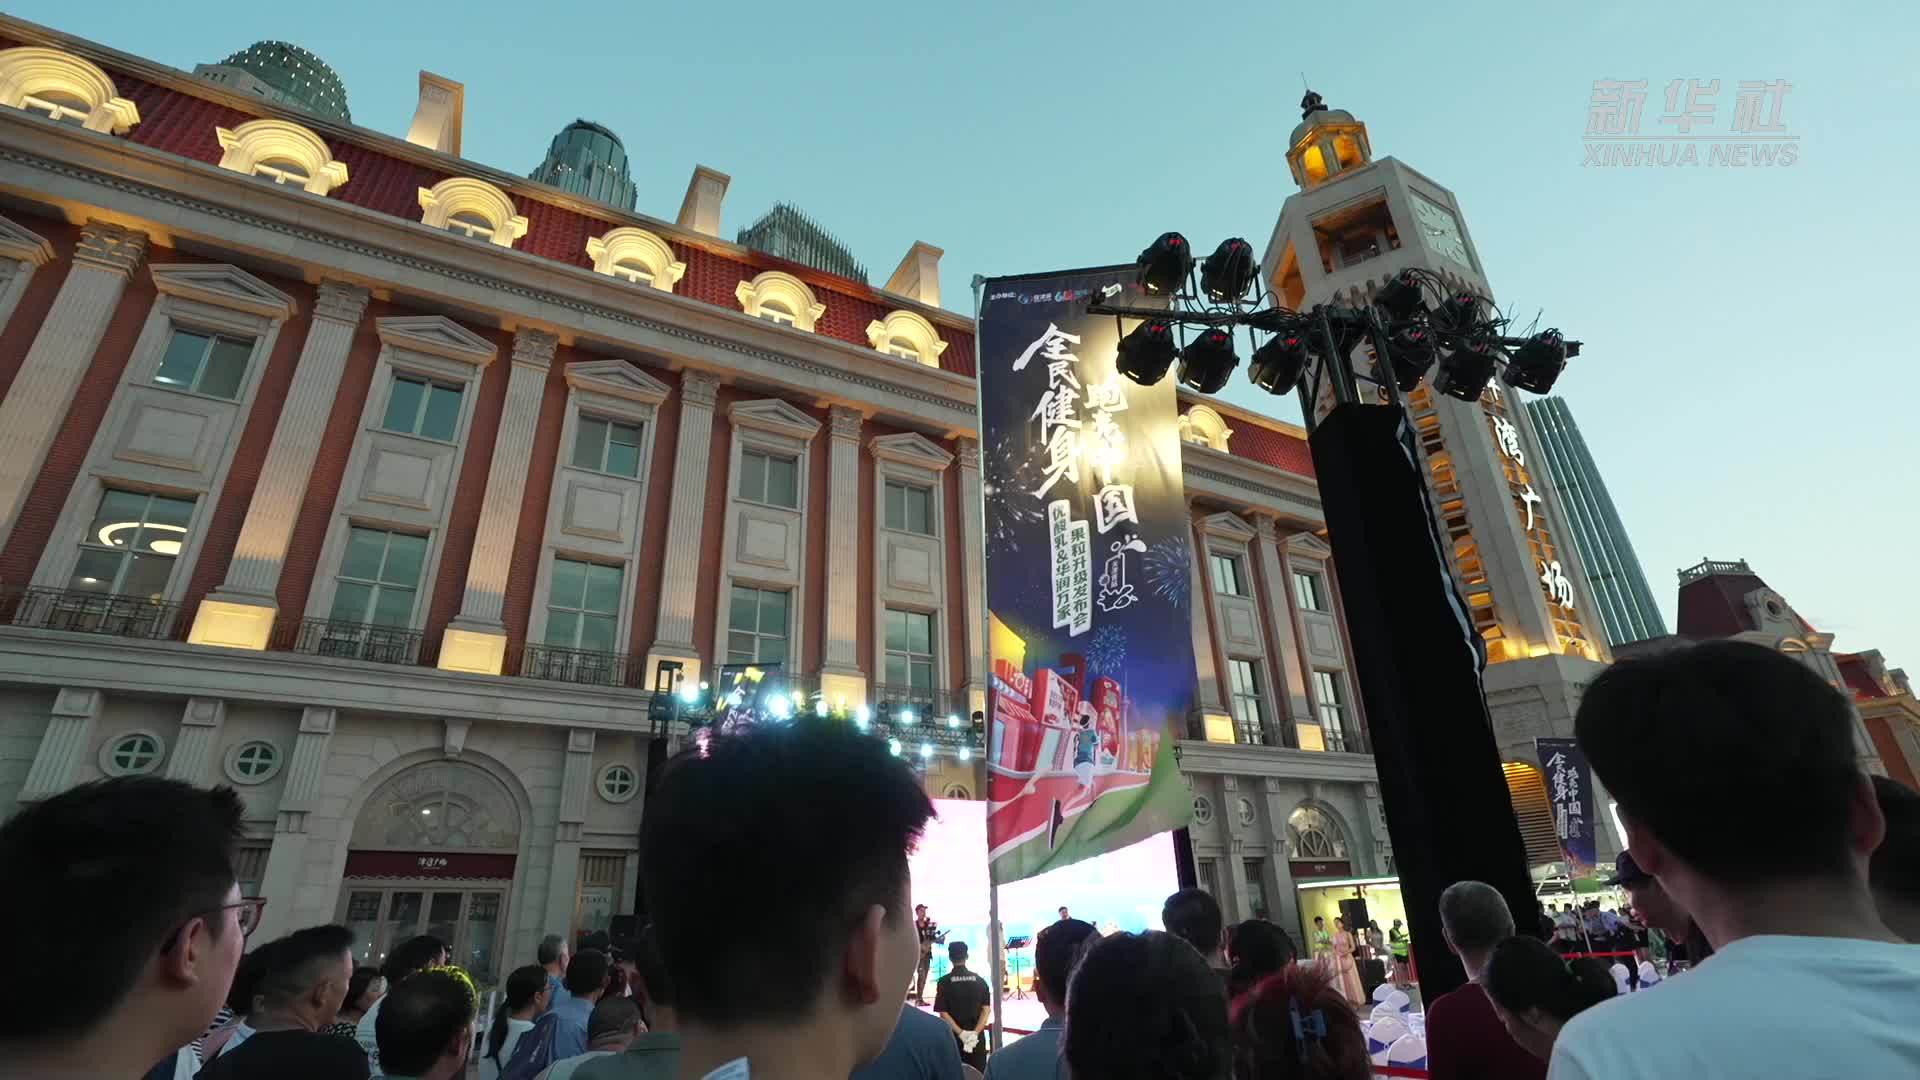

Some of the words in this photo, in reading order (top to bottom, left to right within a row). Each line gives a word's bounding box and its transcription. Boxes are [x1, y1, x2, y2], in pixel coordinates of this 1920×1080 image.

[1012, 322, 1082, 500] 全民健身
[1071, 527, 1088, 629] 果粒升级发布会
